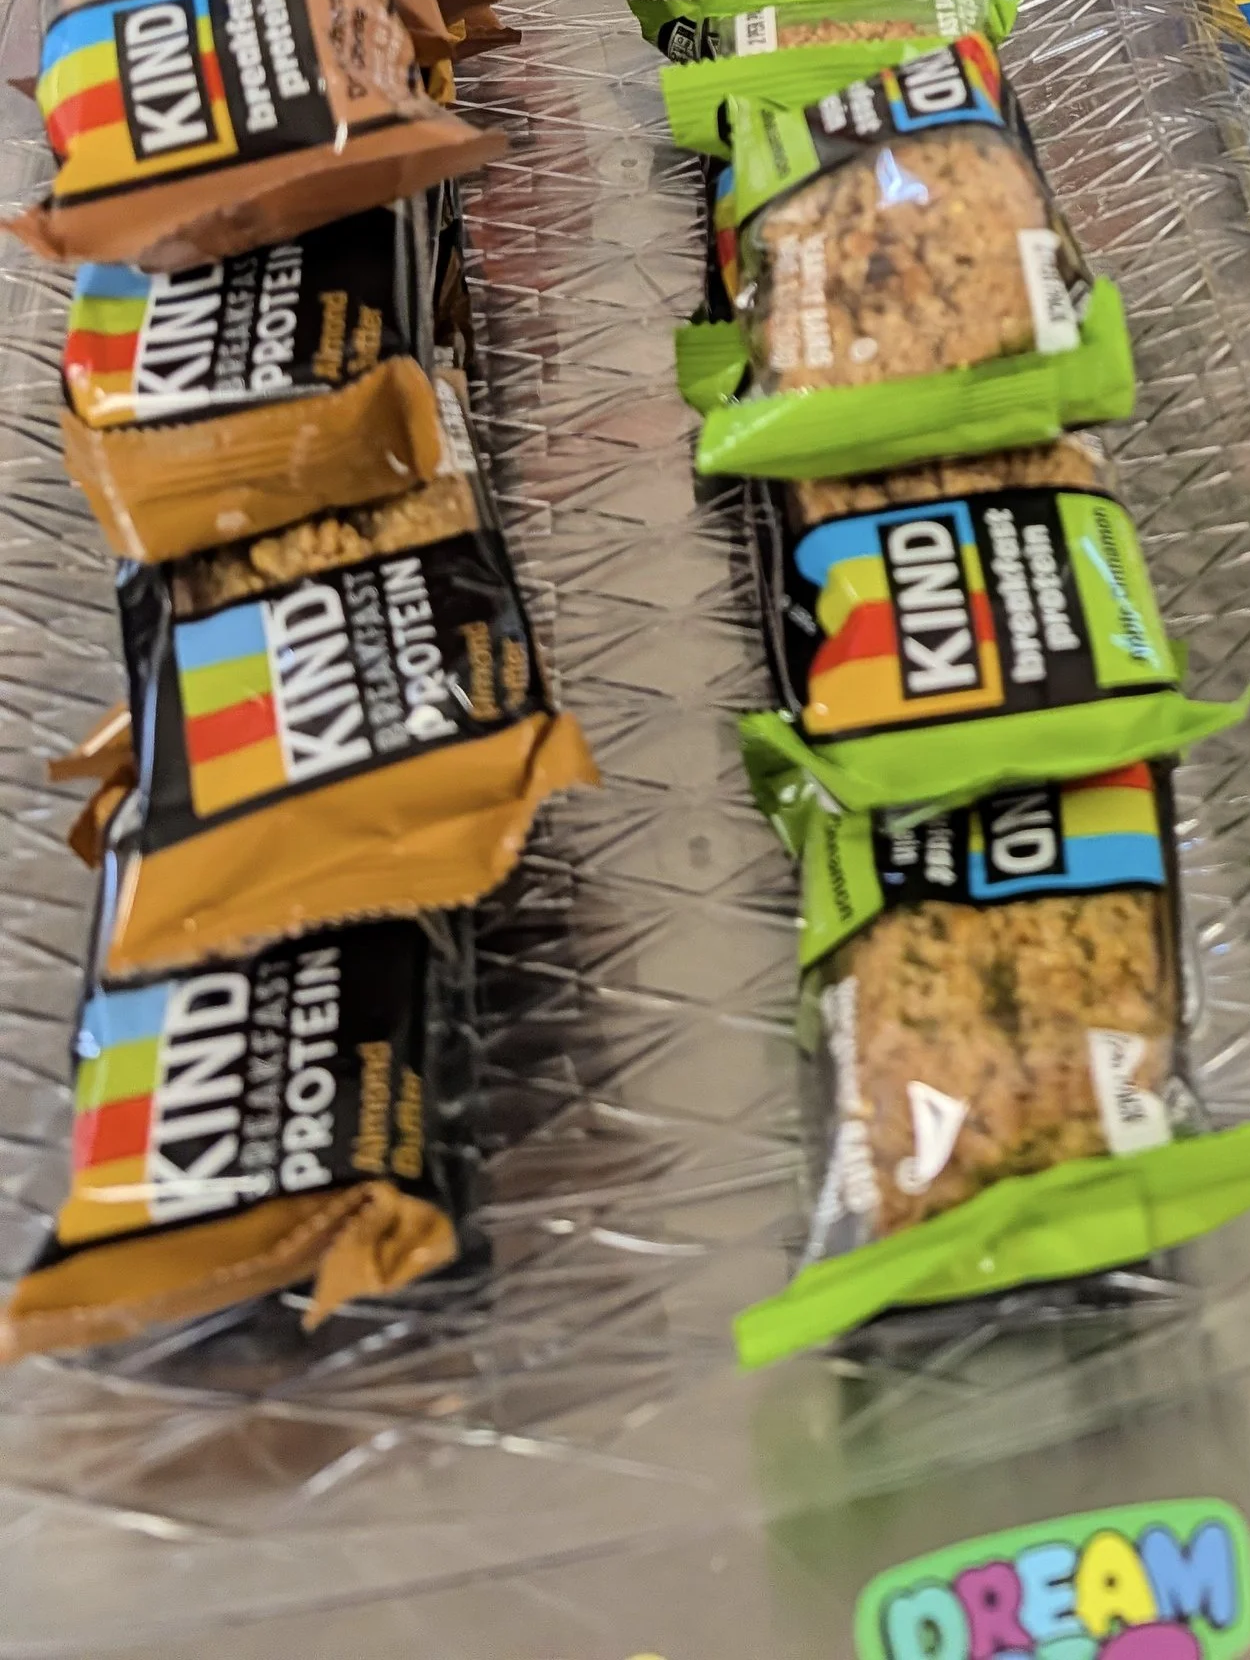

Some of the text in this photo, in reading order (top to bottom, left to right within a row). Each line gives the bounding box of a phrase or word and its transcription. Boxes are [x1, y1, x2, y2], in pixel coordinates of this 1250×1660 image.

[124, 3, 209, 154] KIND
[887, 520, 978, 695] KIND
[981, 507, 1048, 685] breakfast
[1021, 524, 1081, 651] protein
[1092, 505, 1134, 602] Cinnamon
[274, 580, 374, 783] KIND
[343, 569, 409, 752] BREAKFAST
[381, 556, 460, 742] PROTEIN
[151, 971, 250, 1222] KIND
[239, 959, 292, 1197] BREAKFAST
[281, 946, 341, 1192] PROTEIN
[351, 1040, 393, 1173] Almond
[885, 1518, 1238, 1660] DREAM
